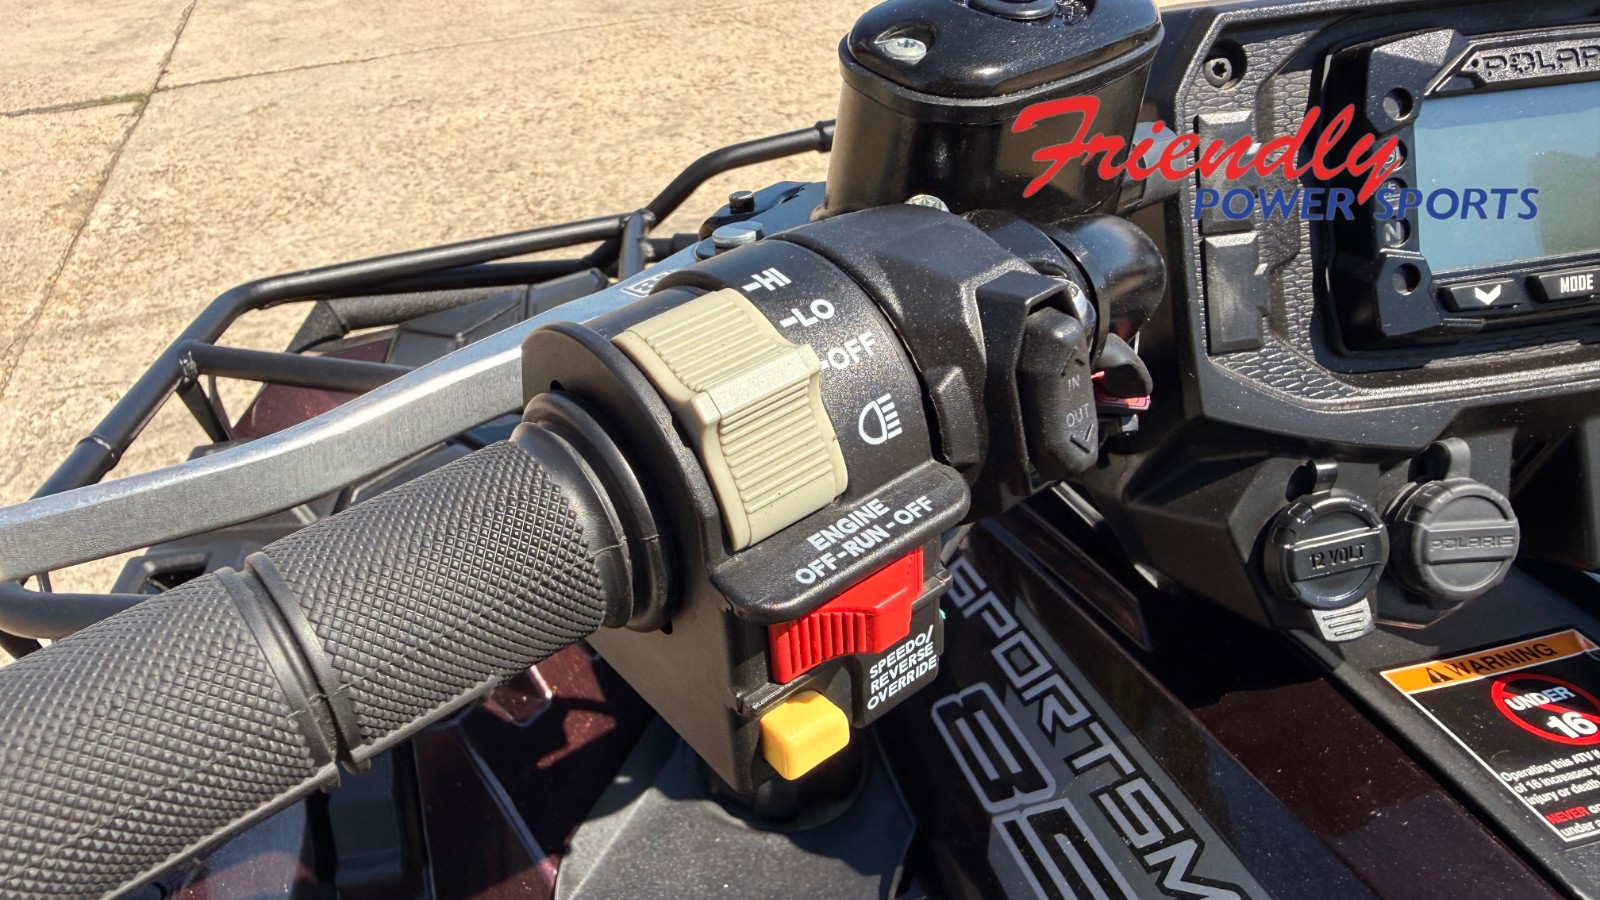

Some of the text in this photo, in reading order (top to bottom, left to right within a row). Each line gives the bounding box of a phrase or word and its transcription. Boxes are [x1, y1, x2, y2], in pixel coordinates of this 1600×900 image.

[1560, 273, 1594, 294] MODE
[1068, 374, 1081, 392] IN
[1066, 403, 1090, 428] OUT
[806, 498, 890, 552] ENGINE
[1310, 543, 1366, 570] 12 VOLT
[1431, 535, 1515, 552] POLARIS
[870, 641, 934, 695] REVERSE
[1443, 642, 1558, 677] WARNING
[866, 654, 938, 711] OVERRIDE
[1504, 685, 1577, 712] UNDER
[1546, 711, 1599, 739] 16
[1500, 763, 1555, 781] Operating
[1550, 757, 1574, 769] this
[1571, 751, 1594, 764] ATV
[1514, 782, 1528, 794] of
[1526, 779, 1543, 790] 16
[1541, 767, 1593, 787] increases
[1524, 791, 1559, 805] injury
[1557, 787, 1572, 797] or
[1545, 806, 1590, 824] NEVER
[1560, 821, 1596, 837] under
